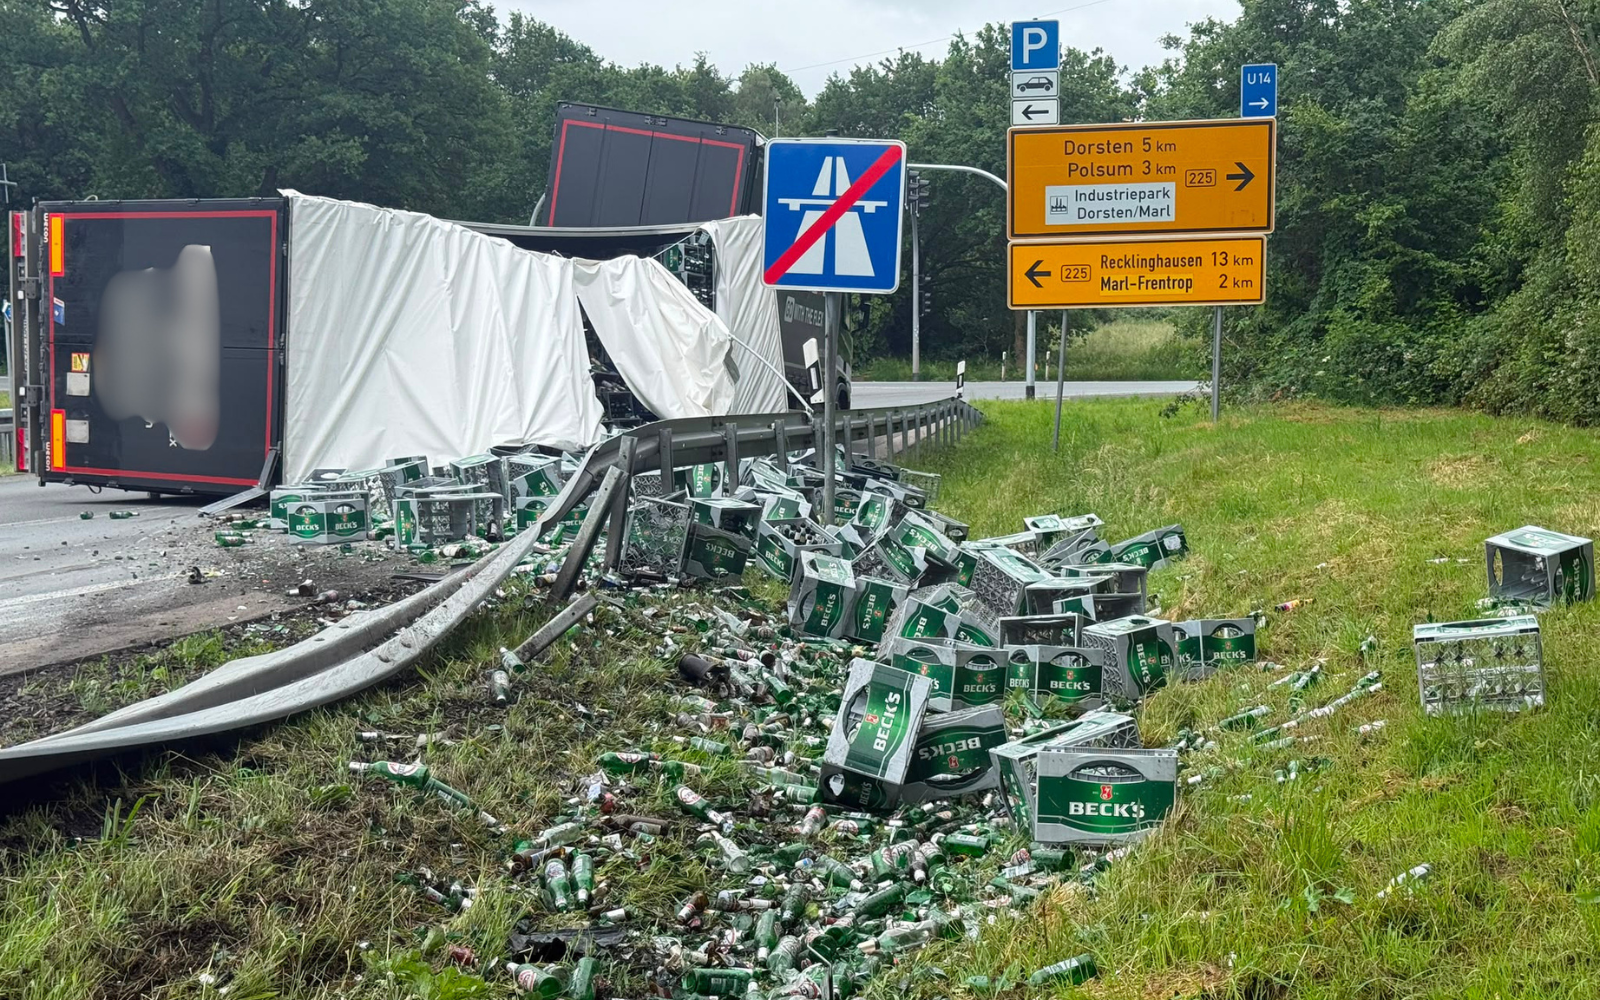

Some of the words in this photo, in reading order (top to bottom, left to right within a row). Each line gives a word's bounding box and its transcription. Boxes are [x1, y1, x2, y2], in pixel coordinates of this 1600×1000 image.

[1023, 28, 1048, 64] P
[1064, 139, 1133, 156] Dorsten
[1142, 137, 1152, 153] 5
[1156, 140, 1177, 152] km
[1068, 161, 1133, 178] Polsum
[1142, 160, 1151, 175] 3
[1156, 163, 1176, 175] km
[1188, 171, 1213, 185] 225
[1075, 188, 1170, 203] Industriepark
[1077, 205, 1171, 220] Dorsten/Marl
[1100, 254, 1202, 272] Recklinghausen
[1211, 252, 1228, 267] 13
[1233, 255, 1254, 267] km
[1065, 267, 1088, 280] 225
[1100, 275, 1193, 293] Marl-Frentrop
[1219, 274, 1228, 289] 2
[1233, 277, 1253, 289] km
[296, 524, 320, 532] BECK'S
[335, 521, 358, 531] BECK'S
[908, 528, 938, 552] BECK'S
[705, 542, 736, 559] BECK'S
[1122, 547, 1149, 562] BECK'S
[765, 550, 785, 572] BECK'S
[821, 593, 836, 627] BECK'S
[862, 594, 877, 630] BECK'S
[1136, 643, 1151, 683] BECK'S
[1213, 649, 1246, 660] BECK'S
[963, 682, 996, 693] BECK'S
[1009, 678, 1030, 688] BECK'S
[1050, 680, 1091, 691] BECK'S
[872, 691, 901, 752] BECK'S
[918, 737, 981, 760] BECK'S
[859, 781, 873, 806] BECK'S
[1068, 801, 1145, 818] BECK'S
